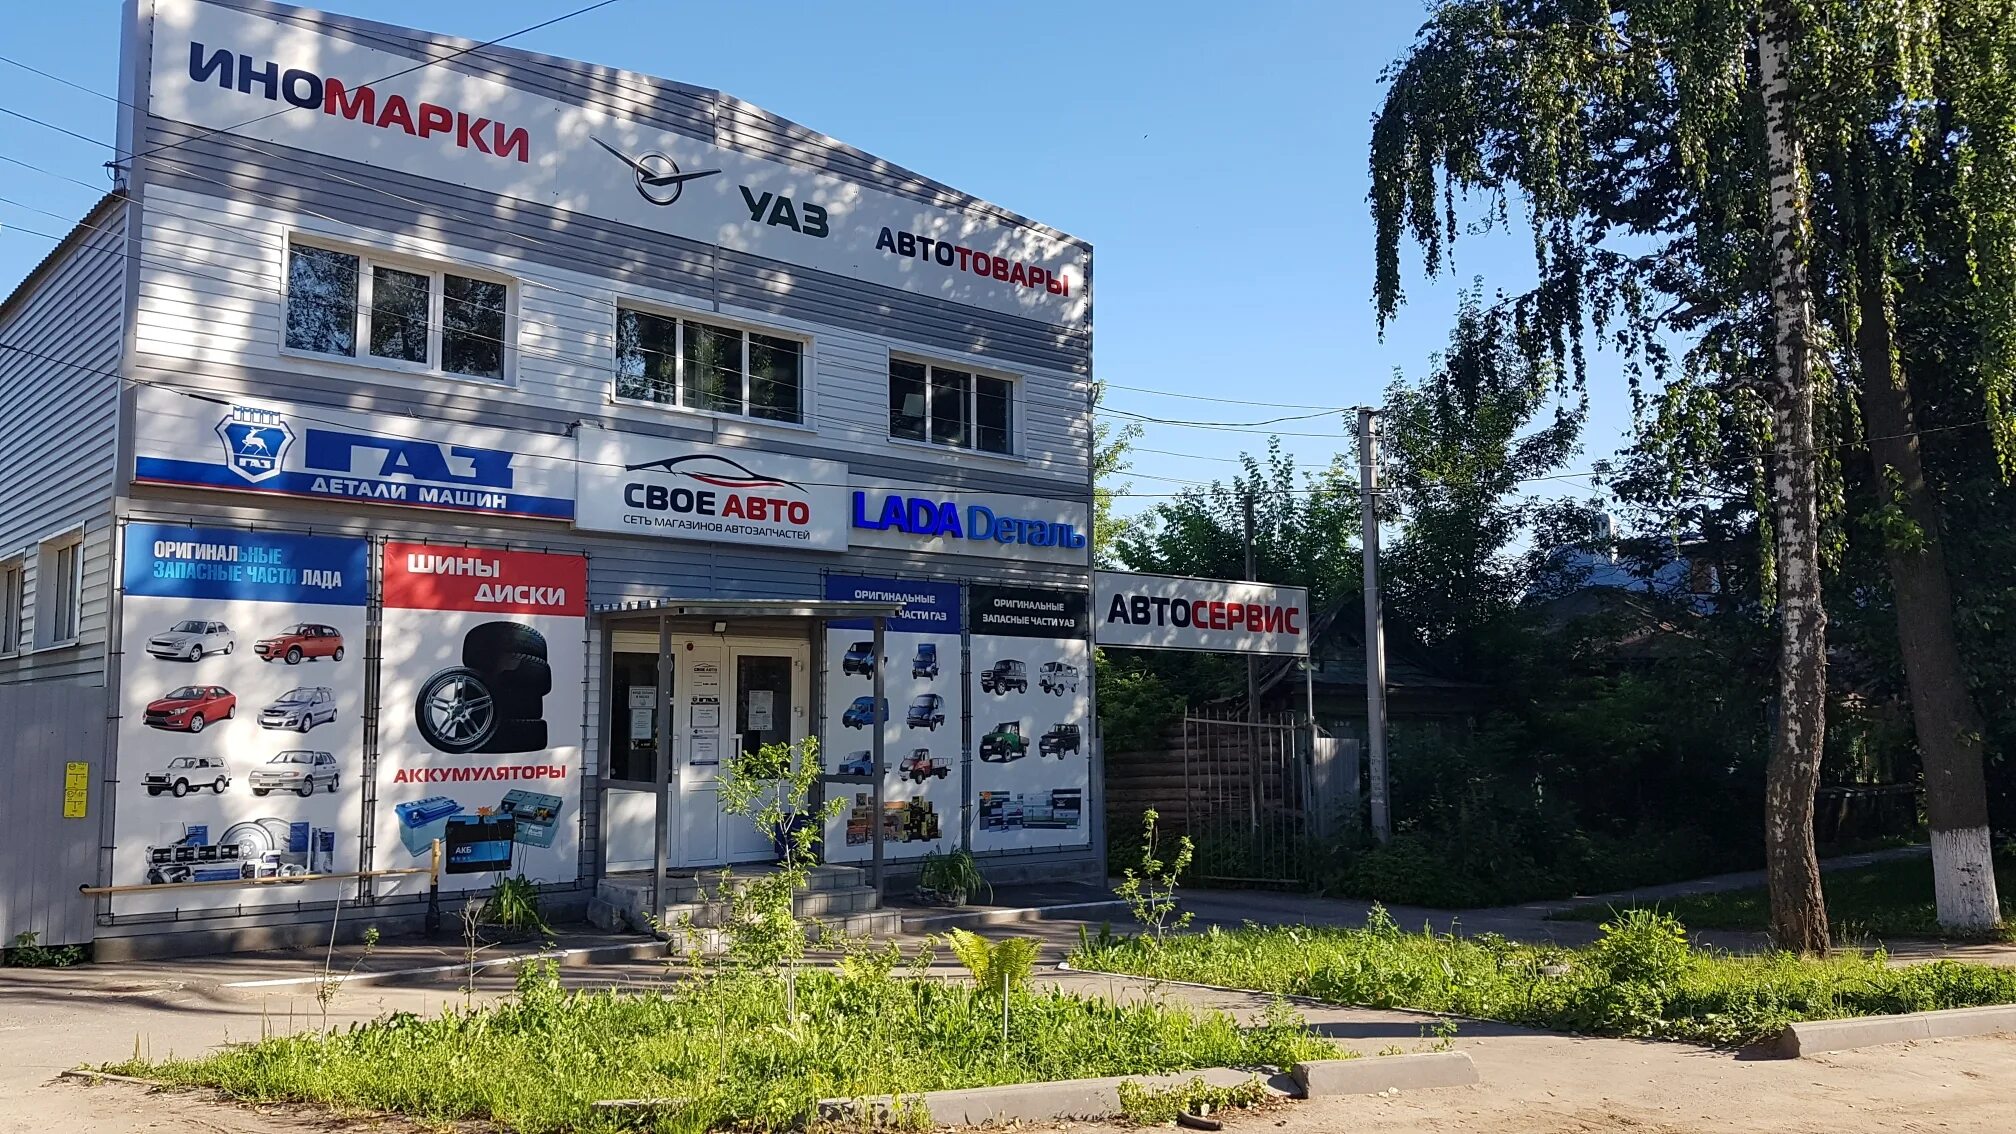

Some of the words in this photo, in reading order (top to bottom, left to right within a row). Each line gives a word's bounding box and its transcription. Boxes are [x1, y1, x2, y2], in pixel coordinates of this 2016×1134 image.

[189, 41, 529, 163] ИНОМАРКИ
[739, 185, 829, 238] УАЗ
[876, 227, 1069, 296] АВТОТОВАРЫ
[239, 457, 271, 469] ГАЗ
[305, 428, 513, 489] ГАЗ
[311, 477, 407, 499] ДЕТАЛИ
[419, 488, 507, 508] МАШИН
[624, 483, 715, 515] СВОЕ
[721, 494, 809, 525] АВТО
[623, 514, 652, 526] СЕТЬ
[654, 517, 723, 533] МАГАЗИНОВ
[725, 526, 811, 540] АВТОЗАПЧАСТЕЙ
[852, 491, 963, 538] LADA
[154, 540, 282, 565] ОРИГИНАЛЬНЫЕ
[153, 560, 242, 582] ЗАПАСНЫЕ
[246, 566, 297, 585] ЧАСТИ
[301, 569, 342, 589] ЛАДА
[408, 553, 500, 578] ШИНЫ
[474, 583, 565, 606] ДИСКИ
[854, 589, 936, 604] ОРИГИНАЛЬНЫЕ
[993, 598, 1065, 611] ОРИГИНАЛЬНЫЕ
[930, 611, 947, 621] ГАЗ
[982, 613, 1030, 625] ЗАПАСНЫЕ
[1030, 616, 1058, 627] ЧАСТИ
[1059, 618, 1075, 628] УАЗ
[1107, 593, 1300, 635] АВТОСЕРВИС
[393, 765, 566, 783] АККУМУЛЯТОРЫ
[455, 846, 472, 854] АКБ
